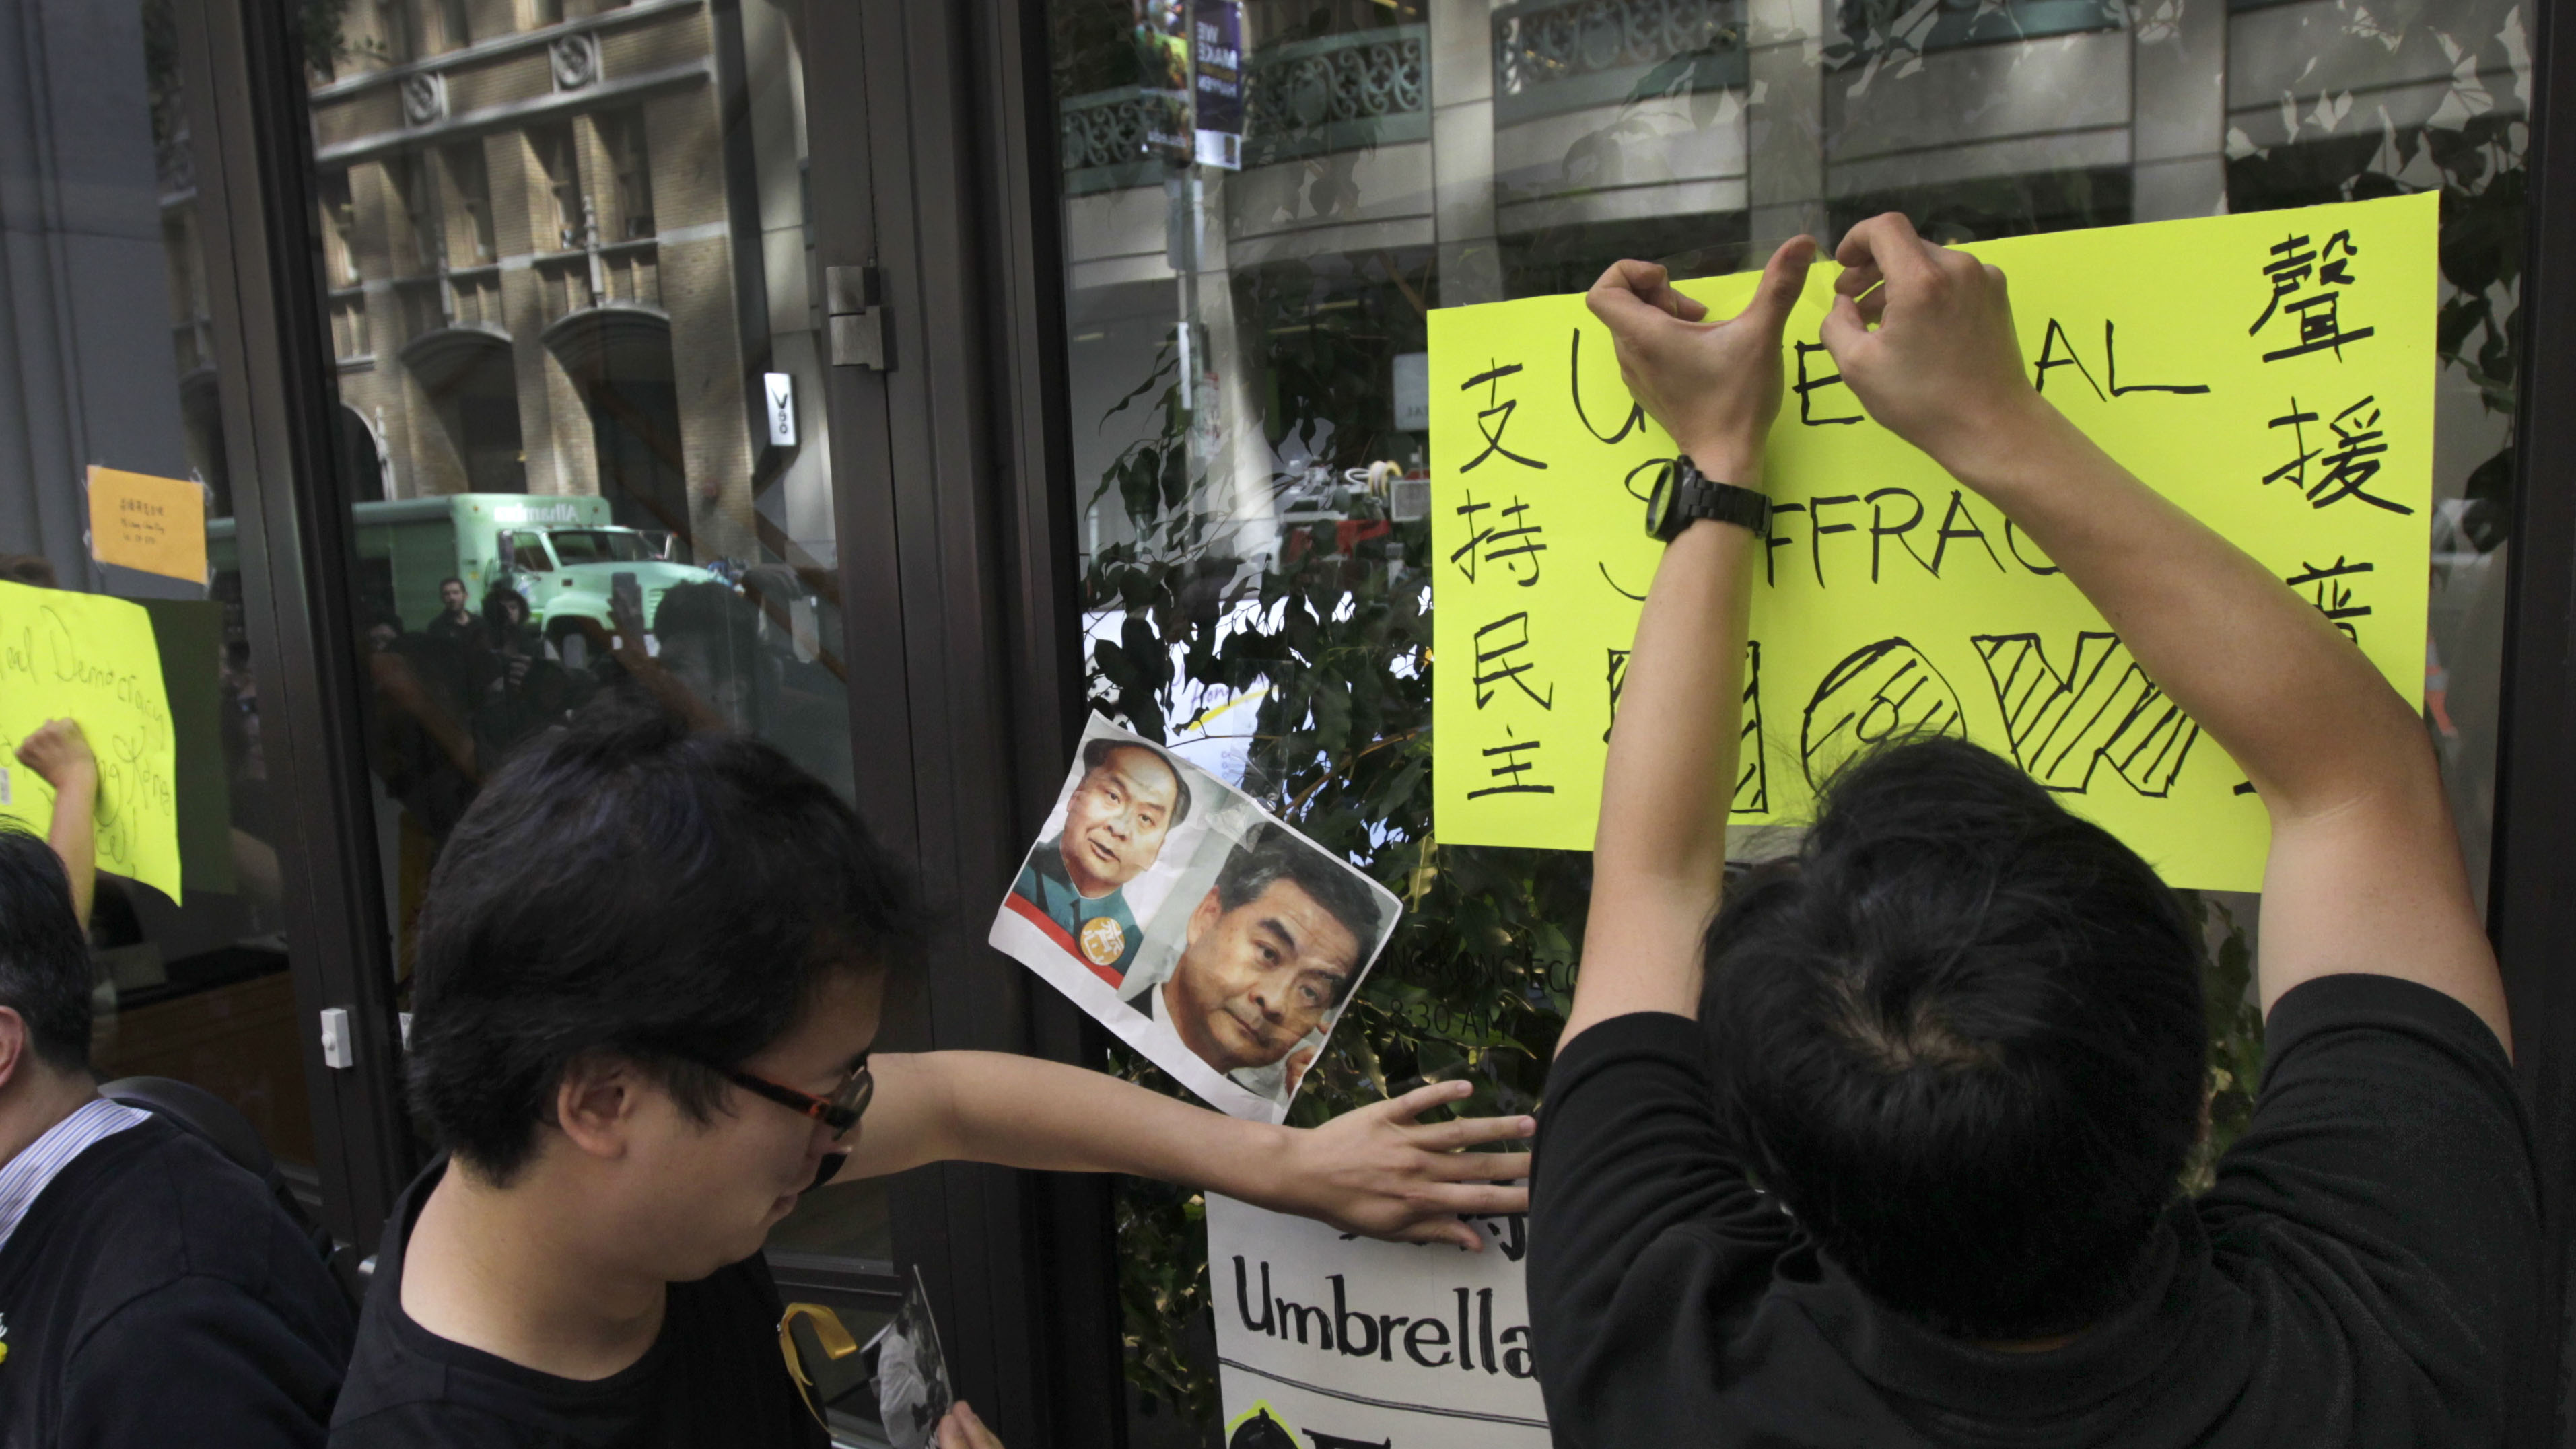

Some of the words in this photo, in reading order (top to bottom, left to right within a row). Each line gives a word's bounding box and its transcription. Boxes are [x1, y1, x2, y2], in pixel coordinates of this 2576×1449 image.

[1451, 357, 1554, 800] 支持民主
[1391, 999, 1451, 1034] 8:30
[1461, 1007, 1506, 1040] AM
[1232, 1254, 1541, 1382] Umbrella
